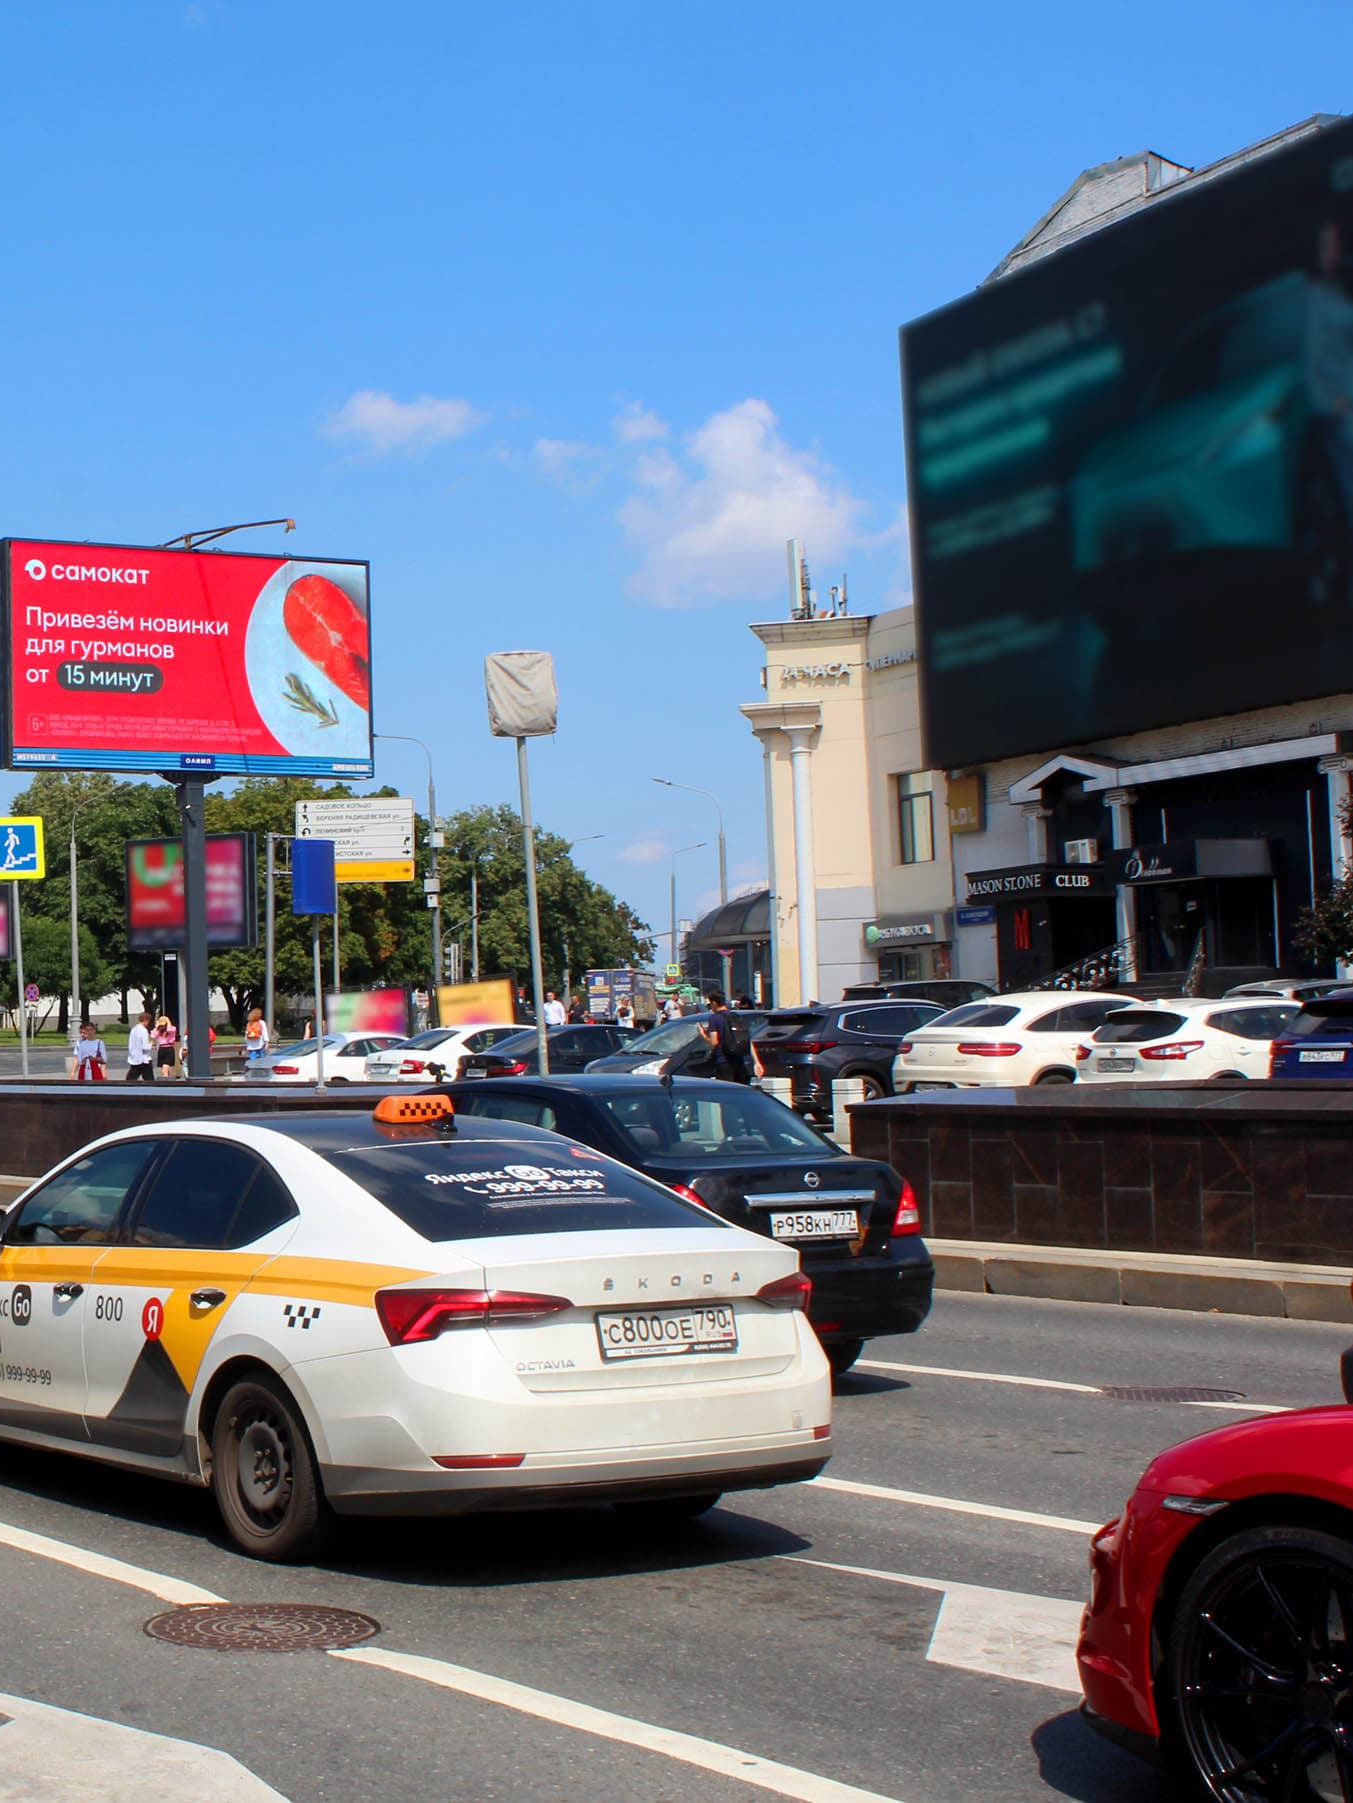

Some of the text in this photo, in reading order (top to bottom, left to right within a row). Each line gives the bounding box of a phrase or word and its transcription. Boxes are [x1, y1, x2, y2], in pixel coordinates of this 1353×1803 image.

[51, 564, 150, 584] самокат
[26, 606, 228, 635] Привезём новинки
[25, 638, 175, 660] для гурманов
[26, 665, 154, 693] от 15 минут
[968, 879, 1003, 896] MASON
[1055, 874, 1090, 887] CLUB
[424, 1170, 510, 1185] Яндекс
[543, 1168, 605, 1178] Такси
[486, 1179, 604, 1194] 999-99-99
[776, 1212, 853, 1234] Р958КН 777
[14, 1292, 31, 1318] Go
[95, 1295, 123, 1321] 800
[147, 1305, 158, 1333] Я
[608, 1309, 727, 1343] С800ОЕ 790
[6, 1365, 52, 1385] 999-99-99
[516, 1359, 576, 1372] OCTAVIA
